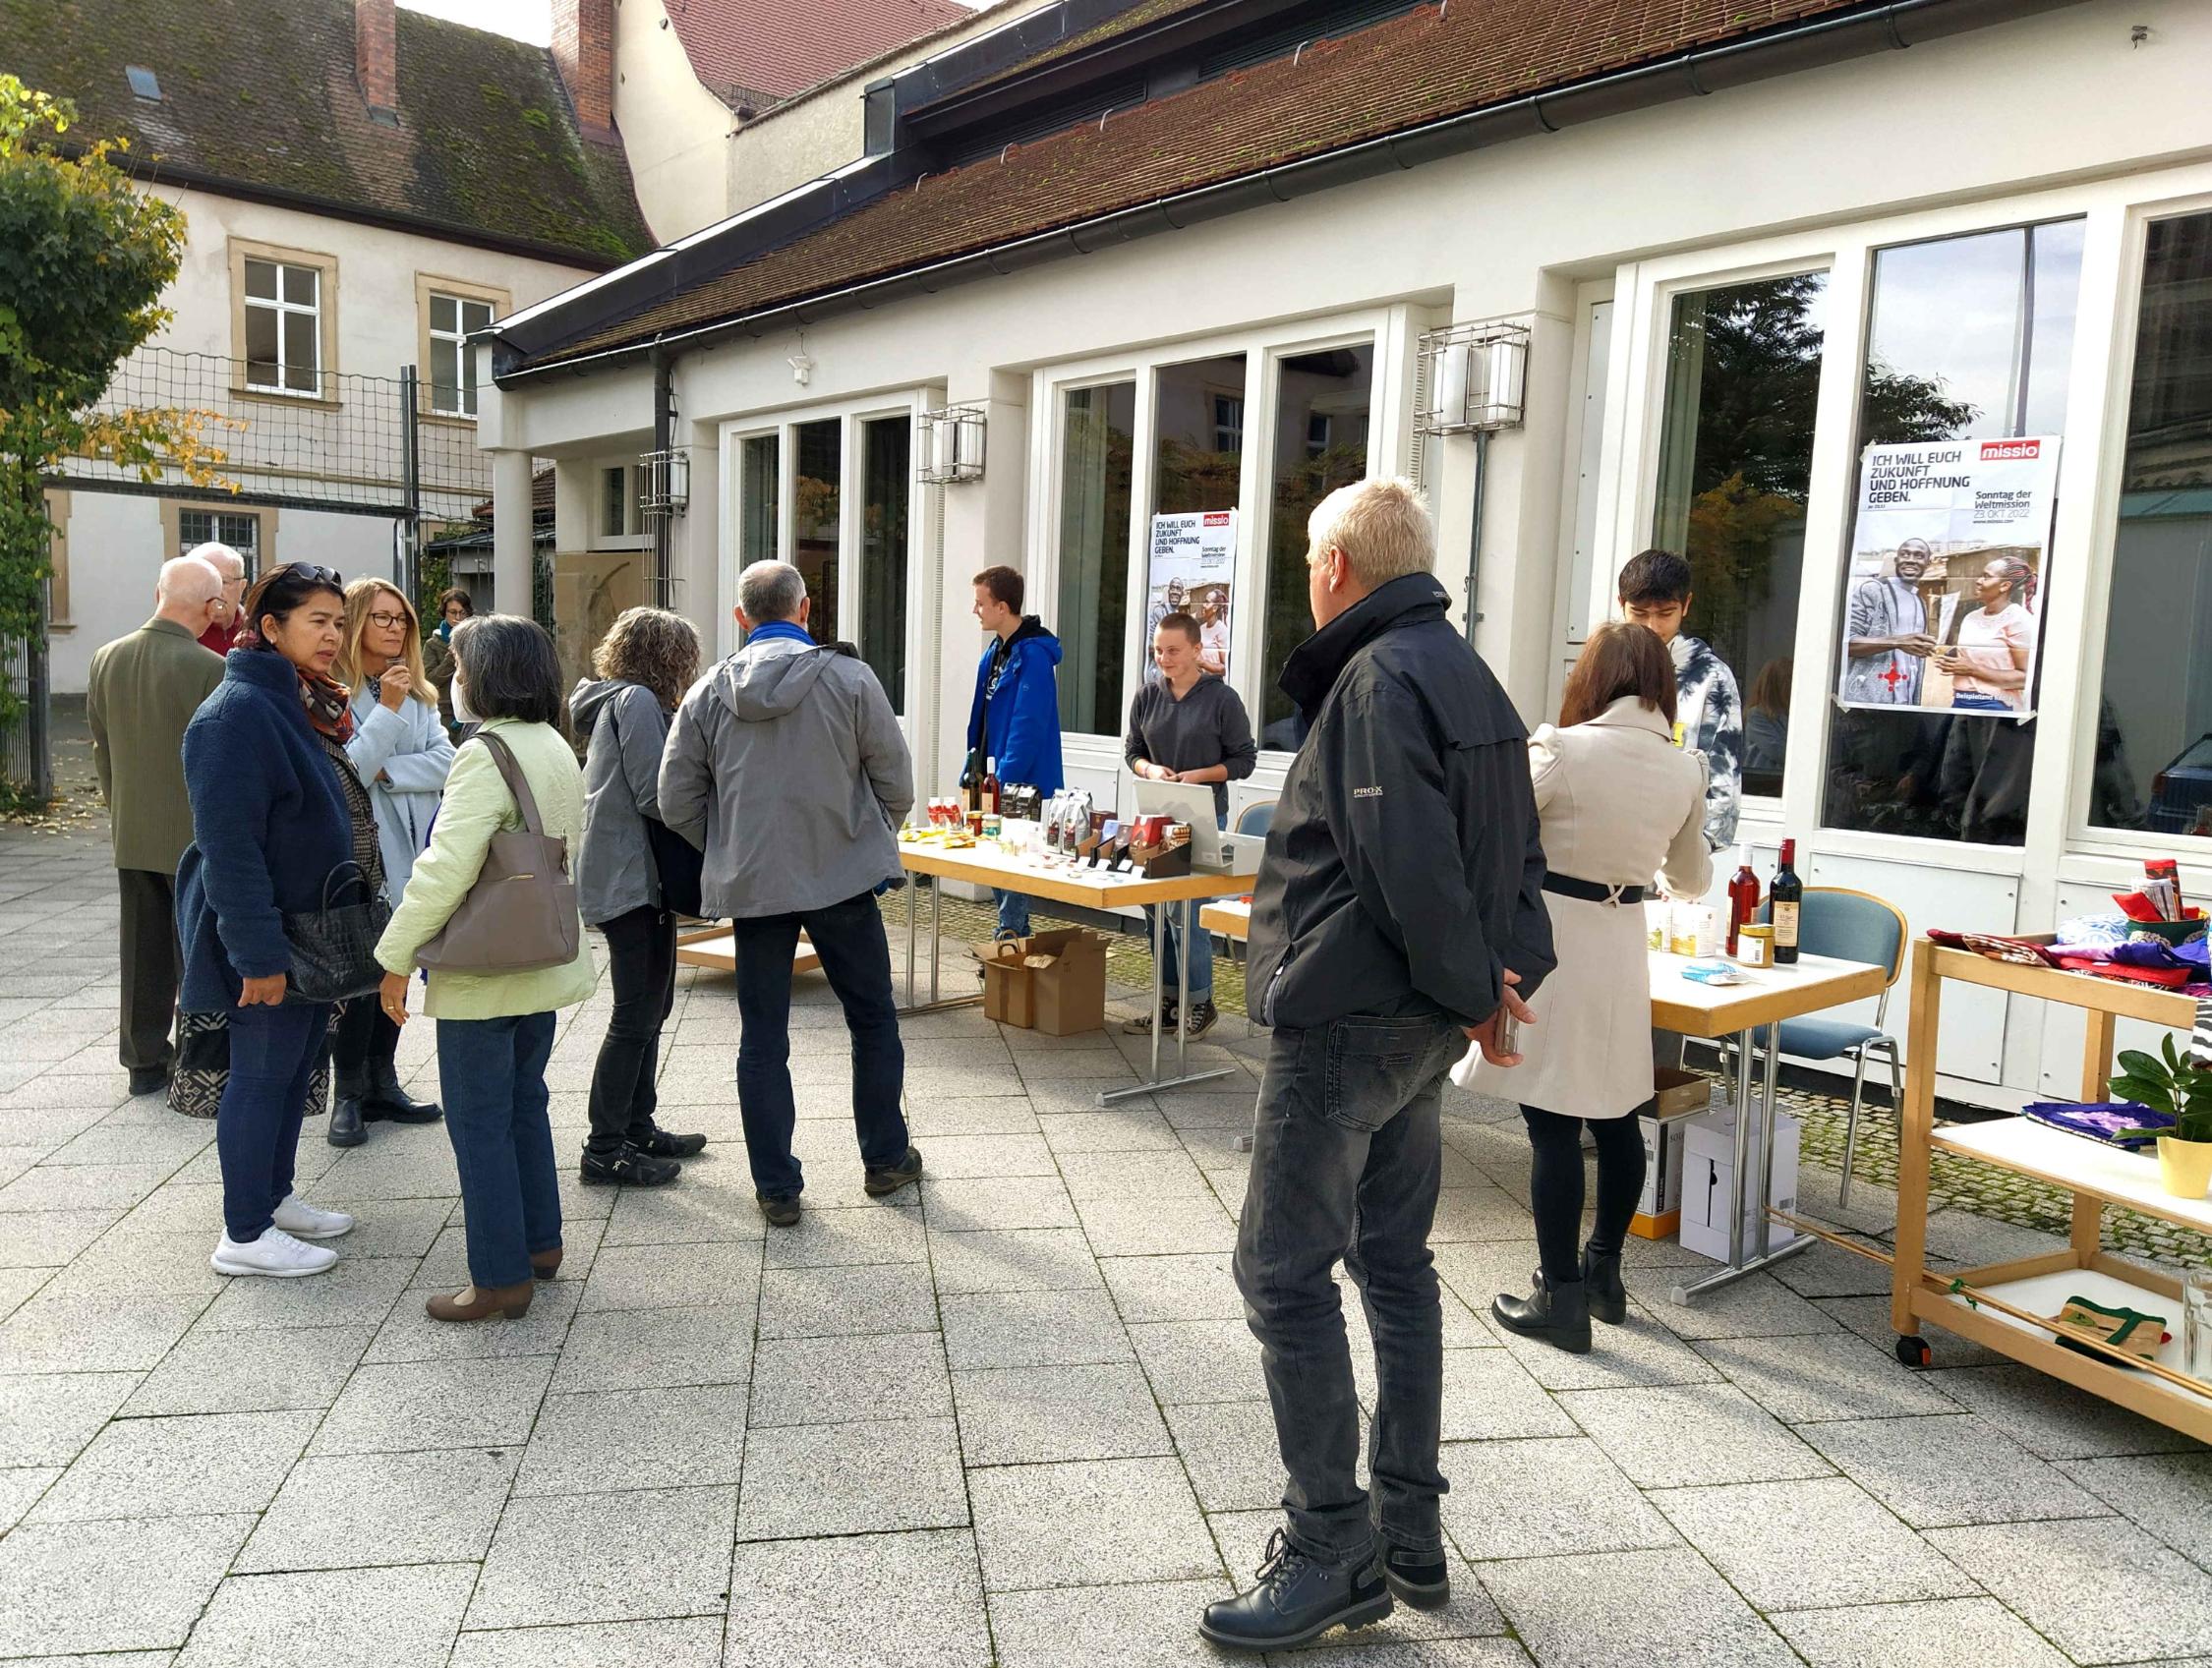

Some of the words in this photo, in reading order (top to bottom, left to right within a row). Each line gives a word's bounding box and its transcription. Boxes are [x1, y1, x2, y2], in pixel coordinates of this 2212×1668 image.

[1981, 442, 2038, 459] missio
[1872, 454, 1892, 466] ICH
[1895, 452, 1924, 465] WILL
[1927, 450, 1961, 463] EUCH
[1870, 465, 1931, 479] ZUKUNFT
[1870, 479, 1896, 491] UND
[1899, 476, 1971, 489] HOFFNUNG
[1869, 490, 1911, 503] GEBEN.
[1975, 490, 2014, 500] Sonntag
[2015, 489, 2032, 498] der
[1974, 499, 2030, 509] Weltmission
[1203, 515, 1229, 526] missio
[1156, 529, 1182, 538] ZUKUNFT
